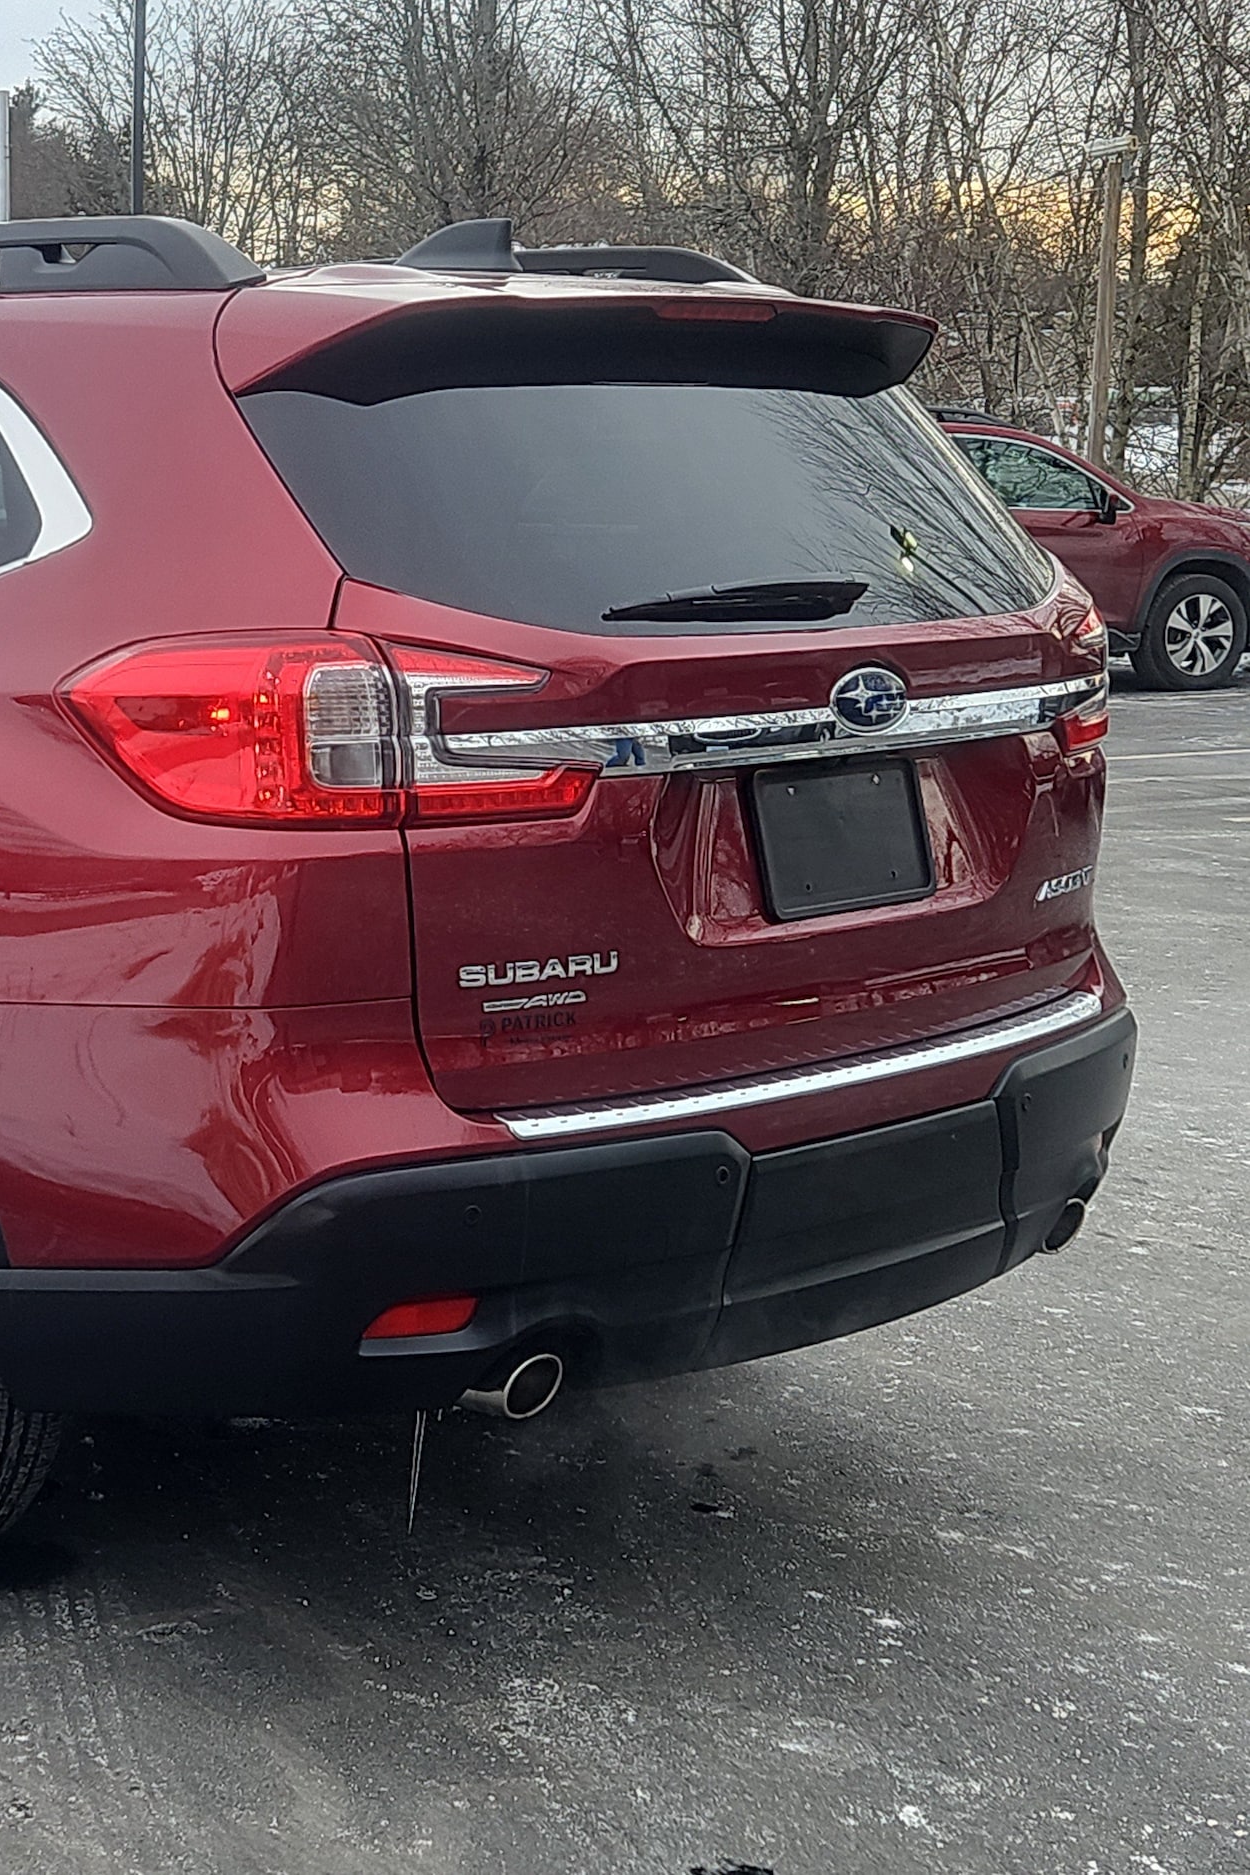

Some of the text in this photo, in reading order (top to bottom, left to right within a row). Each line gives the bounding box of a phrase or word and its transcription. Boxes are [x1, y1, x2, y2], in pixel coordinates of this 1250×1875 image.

[458, 951, 618, 988] SUBARU
[523, 990, 586, 1009] AWD
[501, 1011, 577, 1033] PATRICK
